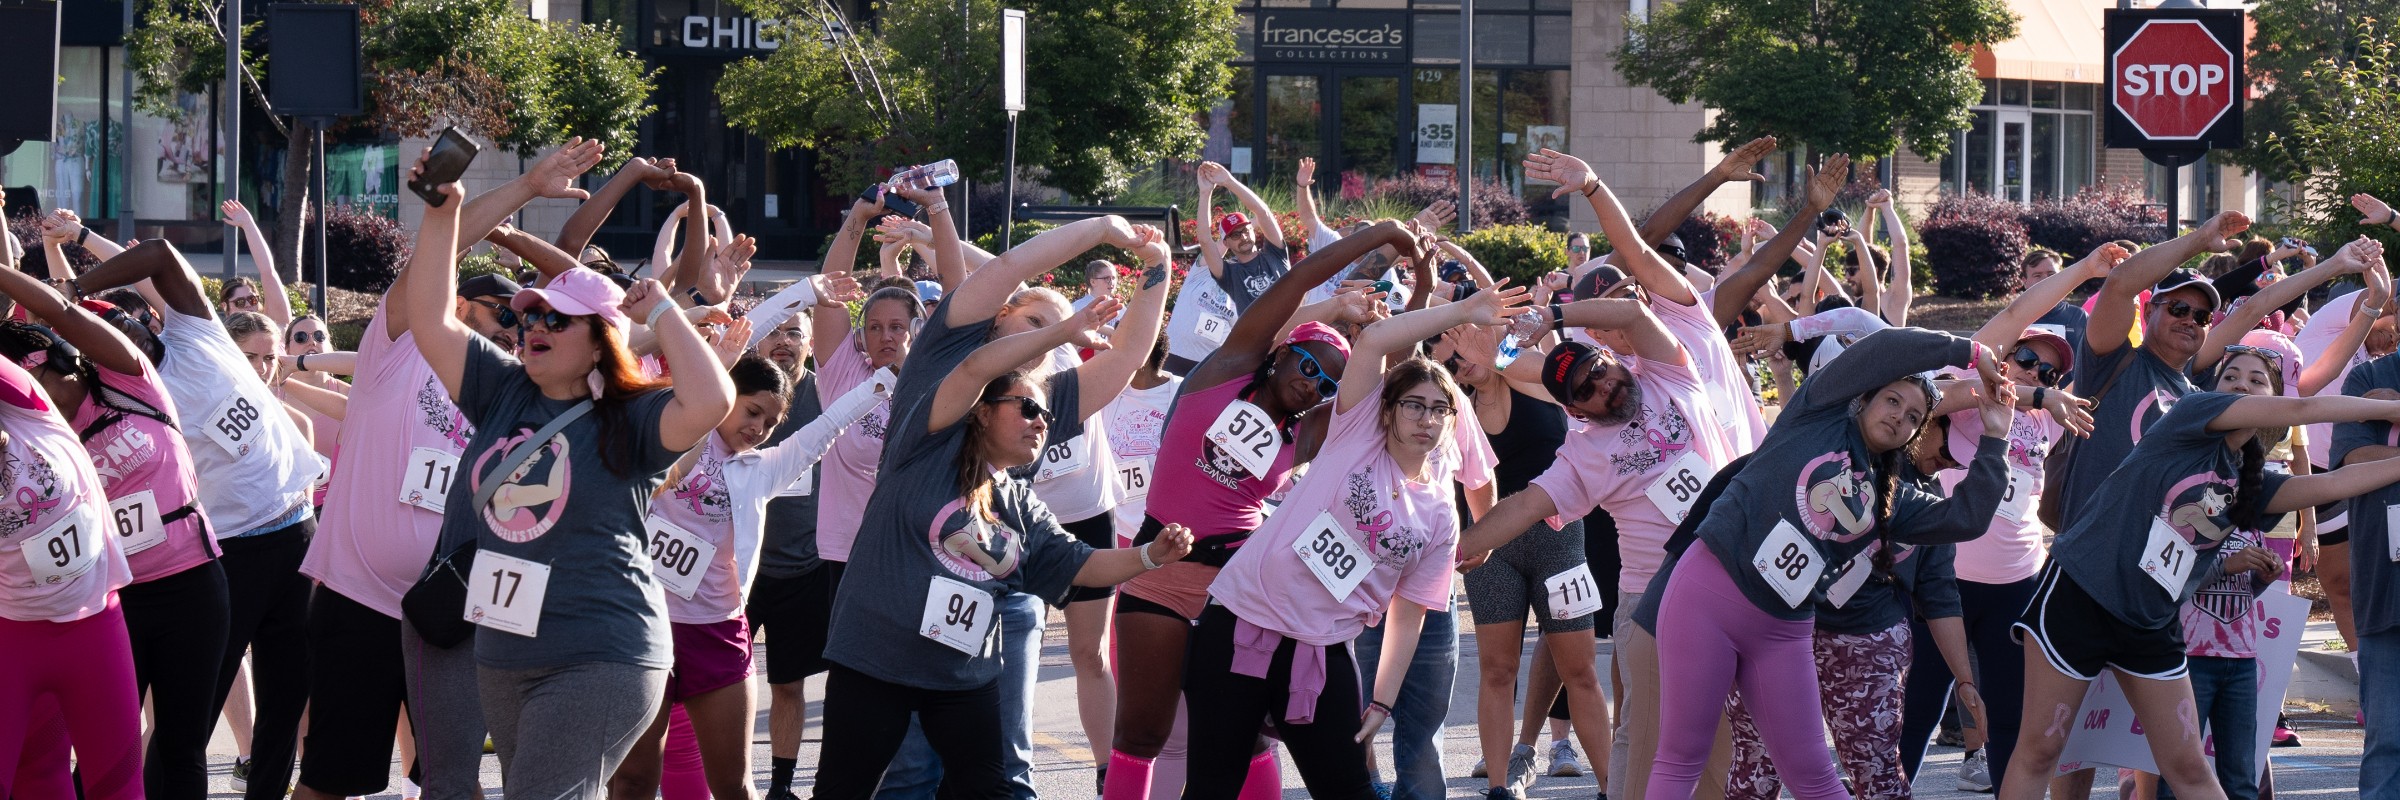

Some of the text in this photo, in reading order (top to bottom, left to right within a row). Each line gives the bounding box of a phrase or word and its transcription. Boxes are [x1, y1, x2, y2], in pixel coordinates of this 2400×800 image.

[1262, 16, 1402, 44] francesca's
[1275, 50, 1388, 60] COLLECTIONS
[1417, 70, 1442, 83] 429
[2123, 63, 2224, 96] STOP
[1420, 123, 1454, 140] $35
[356, 193, 399, 204] CHICO'S
[1204, 319, 1219, 333] 87
[216, 397, 259, 442] 568
[1228, 409, 1274, 459] 572
[424, 459, 451, 495] 11
[1119, 466, 1144, 491] 75
[1194, 457, 1238, 490] DEMONS
[1665, 468, 1702, 503] 56
[1795, 485, 1821, 536] MARICELA'S
[527, 516, 555, 540] TEAM
[48, 523, 82, 568] 97
[651, 529, 699, 577] 590
[1312, 527, 1357, 580] 589
[1774, 542, 1810, 581] 98
[2160, 540, 2184, 577] 41
[491, 568, 523, 608] 17
[1559, 573, 1591, 605] 111
[945, 593, 978, 632] 94
[2083, 708, 2110, 730] OUR
